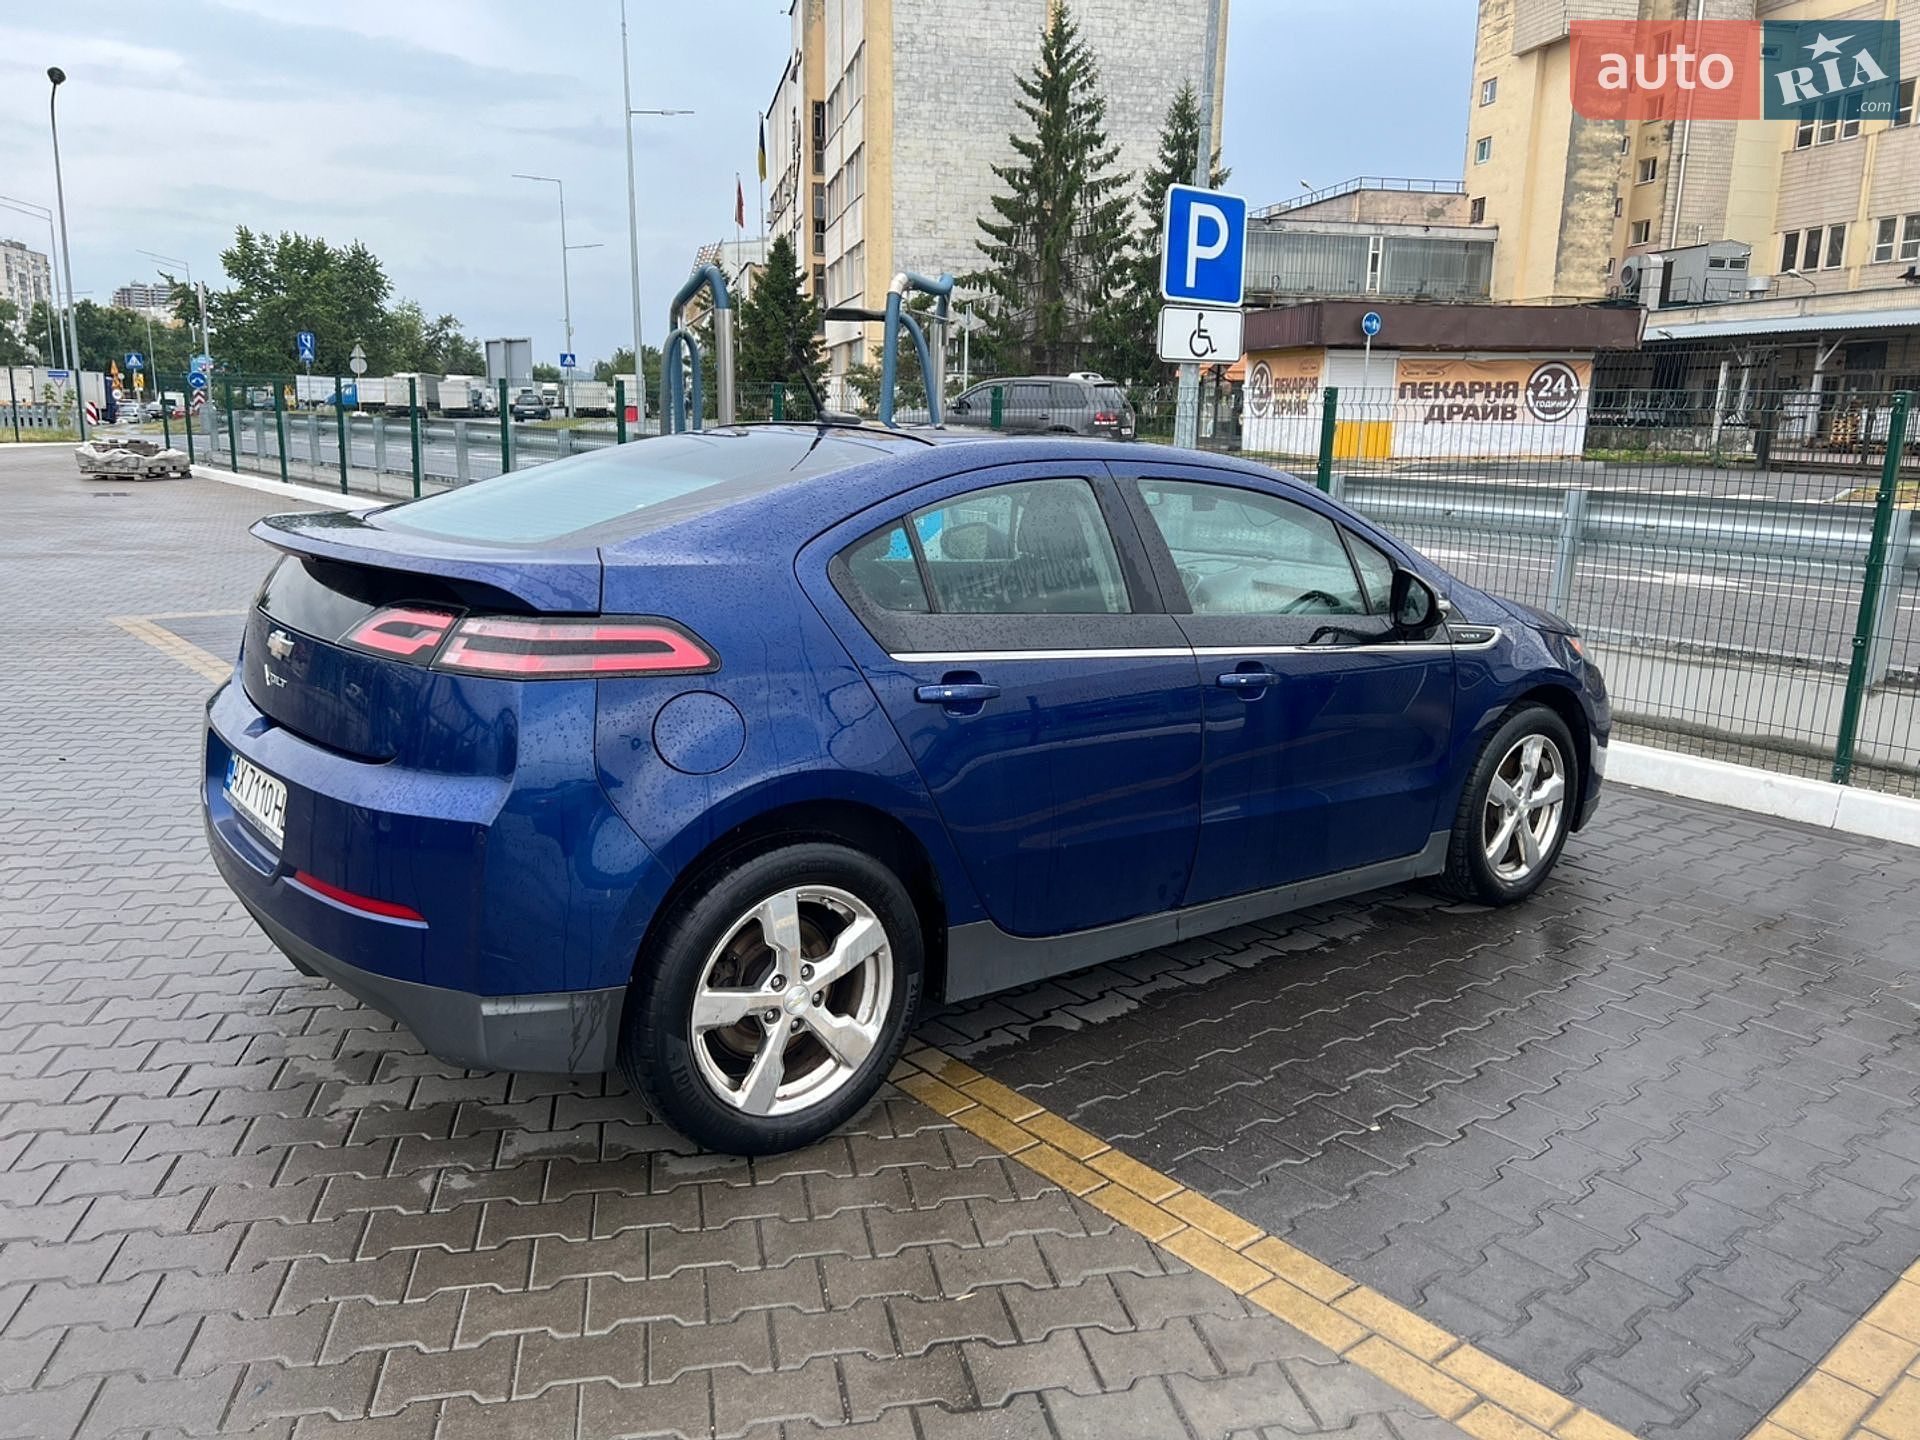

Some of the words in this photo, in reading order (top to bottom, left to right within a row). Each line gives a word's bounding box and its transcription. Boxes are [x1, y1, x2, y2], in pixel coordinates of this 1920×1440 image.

[1186, 202, 1230, 288] P
[1400, 381, 1519, 400] ПЕКАРНЯ
[1538, 374, 1567, 397] 24
[1424, 400, 1517, 424] ДРАЙВ
